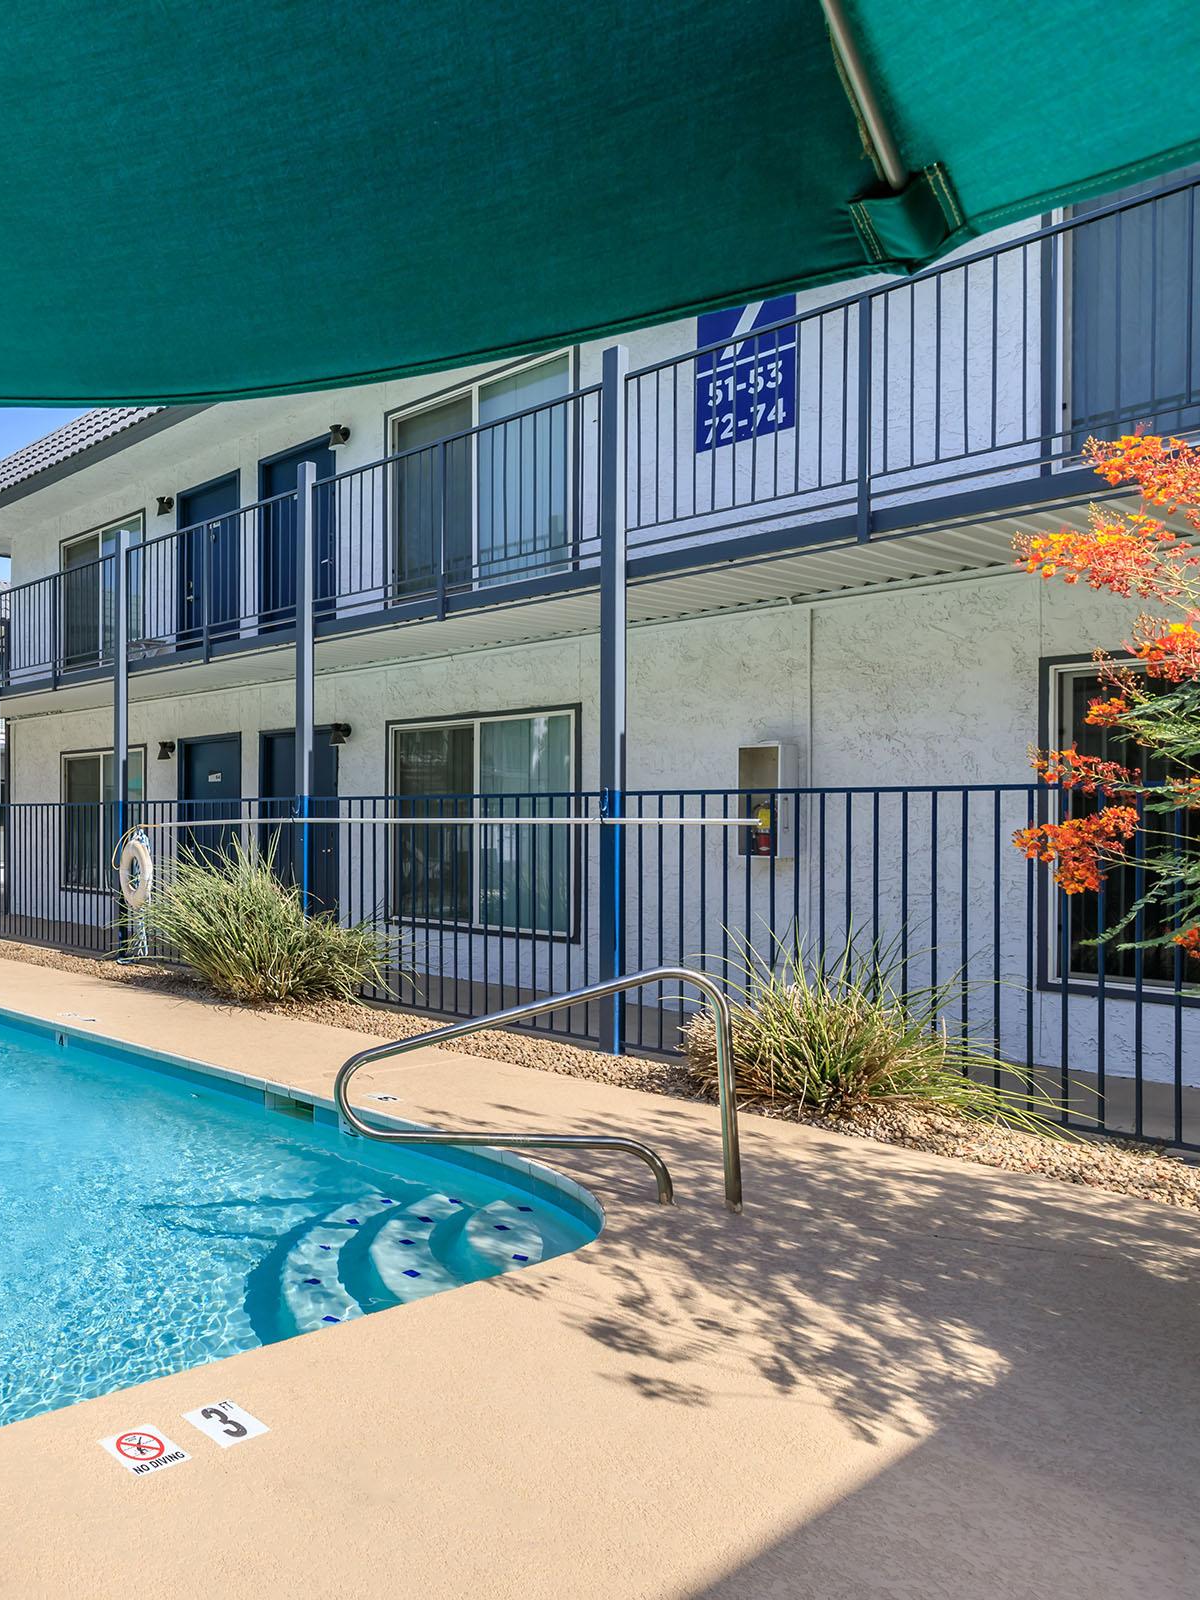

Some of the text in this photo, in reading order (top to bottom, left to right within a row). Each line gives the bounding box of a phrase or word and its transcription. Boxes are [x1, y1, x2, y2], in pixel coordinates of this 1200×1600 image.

[707, 360, 783, 407] 51-53
[704, 397, 786, 444] 72-74
[218, 1401, 234, 1411] FT
[201, 1407, 247, 1438] 3
[132, 1451, 185, 1475] NO DIVING
